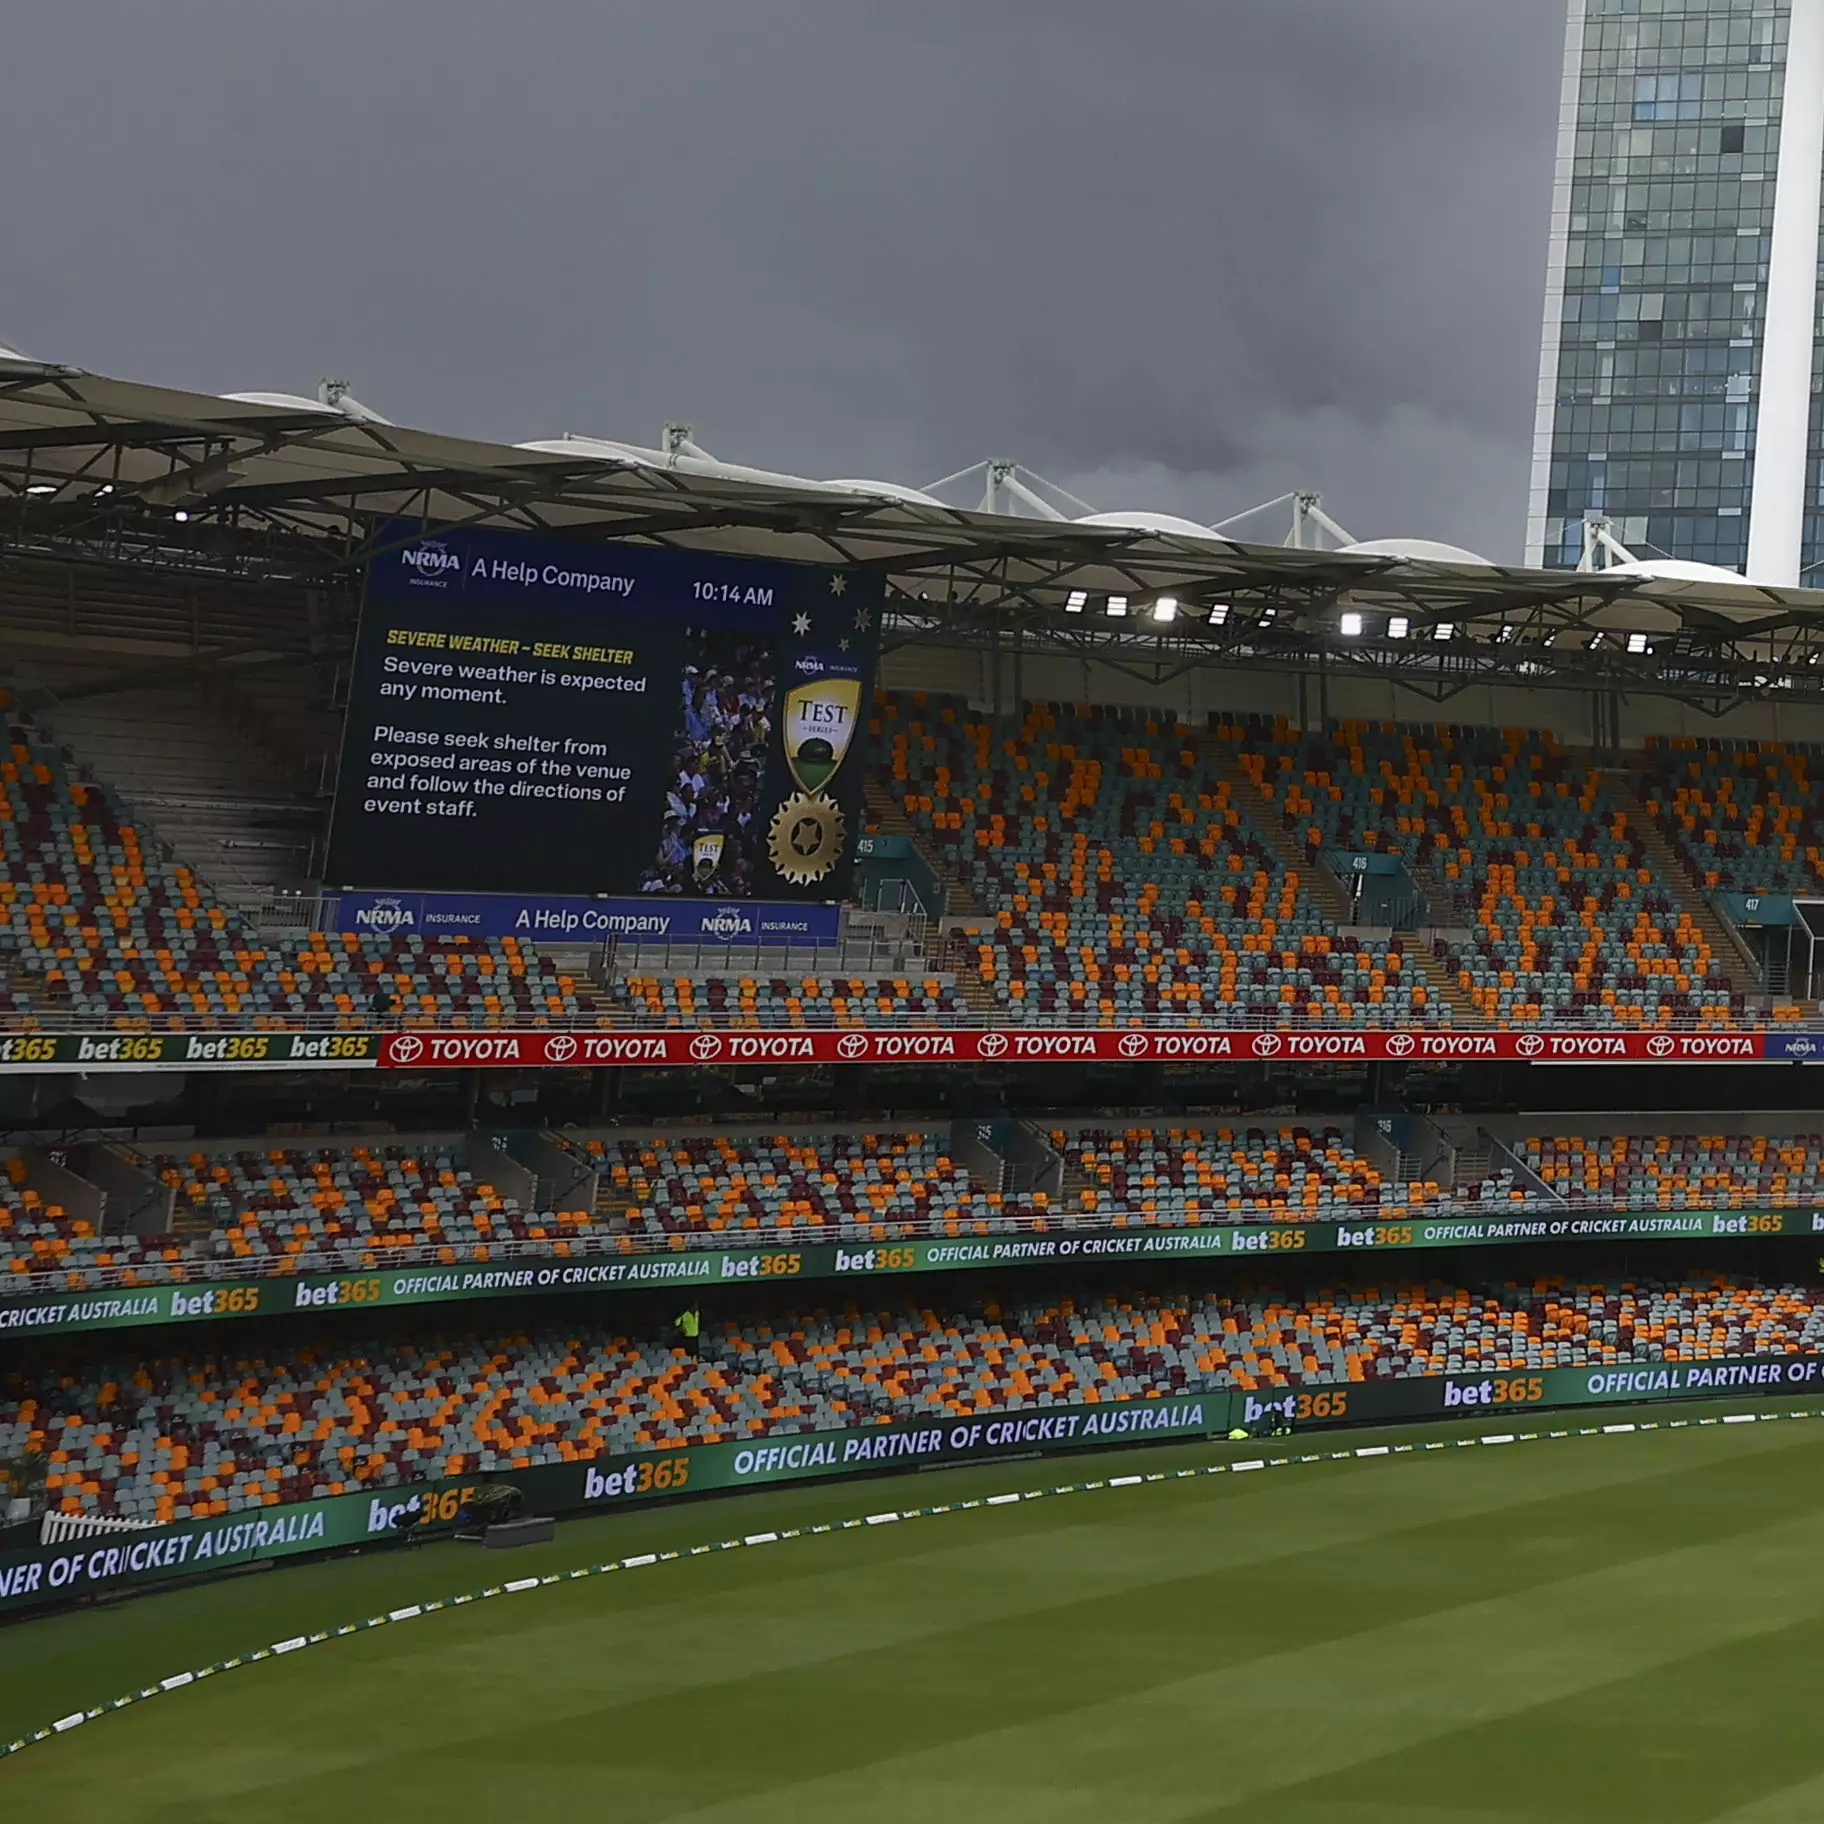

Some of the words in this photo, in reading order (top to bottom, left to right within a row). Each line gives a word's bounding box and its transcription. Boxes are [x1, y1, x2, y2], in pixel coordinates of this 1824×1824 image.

[402, 549, 460, 570] NRMA
[472, 558, 488, 576] A
[491, 559, 538, 585] Help
[542, 566, 634, 596] Company
[693, 581, 741, 603] 10:14
[743, 587, 773, 606] AM
[387, 629, 446, 649] SEVERE
[448, 634, 519, 655] WEATHER
[533, 642, 572, 661] SEEK
[573, 645, 634, 665] SHELTER
[383, 657, 455, 677] Severe
[458, 664, 537, 683] weather
[540, 669, 556, 686] is
[560, 671, 646, 694] expected
[380, 681, 416, 701] any
[421, 684, 507, 705] moment.
[798, 700, 848, 724] TEST
[374, 726, 440, 745] Please
[443, 730, 488, 749] seek
[494, 734, 559, 754] shelter
[563, 738, 607, 755] from
[370, 751, 456, 771] exposed
[459, 757, 512, 773] areas
[517, 759, 537, 776] of
[540, 759, 572, 777] the
[576, 765, 632, 780] venue
[367, 774, 404, 790] and
[410, 774, 469, 794] follow
[473, 778, 504, 796] the
[509, 780, 601, 800] directions
[606, 784, 625, 801] of
[364, 798, 423, 814] event
[426, 798, 478, 817] staff.
[1745, 899, 1760, 911] 417
[356, 910, 414, 926] NRMA
[426, 913, 480, 924] INSURANCE
[516, 909, 533, 929] A
[535, 909, 578, 930] Help
[582, 910, 669, 933] Company
[701, 916, 752, 933] NRMA
[761, 921, 808, 932] INSURANCE
[78, 1038, 163, 1061] bet365
[290, 1036, 369, 1058] bet365
[430, 1039, 520, 1060] TOYOTA
[729, 1038, 814, 1056] TOYOTA
[1014, 1036, 1096, 1054] TOYOTA
[1288, 1036, 1365, 1054] TOYOTA
[1550, 1037, 1626, 1054] TOYOTA
[1424, 1222, 1485, 1239] OFFICIAL
[1488, 1221, 1546, 1237] PARTNER
[1550, 1220, 1569, 1235] OF
[1572, 1219, 1626, 1234] CRICKET
[1629, 1217, 1703, 1233] AUSTRALIA
[1712, 1214, 1782, 1232] bet365
[394, 1274, 459, 1295] OFFICIAL
[463, 1271, 533, 1291] PARTNER
[537, 1269, 559, 1285] OF
[563, 1267, 625, 1284] CRICKET
[628, 1261, 709, 1281] AUSTRALIA
[721, 1254, 800, 1278] bet365
[171, 1289, 259, 1316] bet365
[1588, 1370, 1684, 1395] OFFICIAL
[1688, 1363, 1781, 1388] PARTNER
[1787, 1361, 1816, 1381] OF
[1444, 1377, 1543, 1408] bet365
[735, 1443, 837, 1473] OFFICIAL
[843, 1429, 943, 1462] PARTNER
[950, 1427, 983, 1448] OF
[986, 1418, 1079, 1445] CRICKET
[1083, 1403, 1203, 1437] AUSTRALIA
[585, 1456, 689, 1500] bet365
